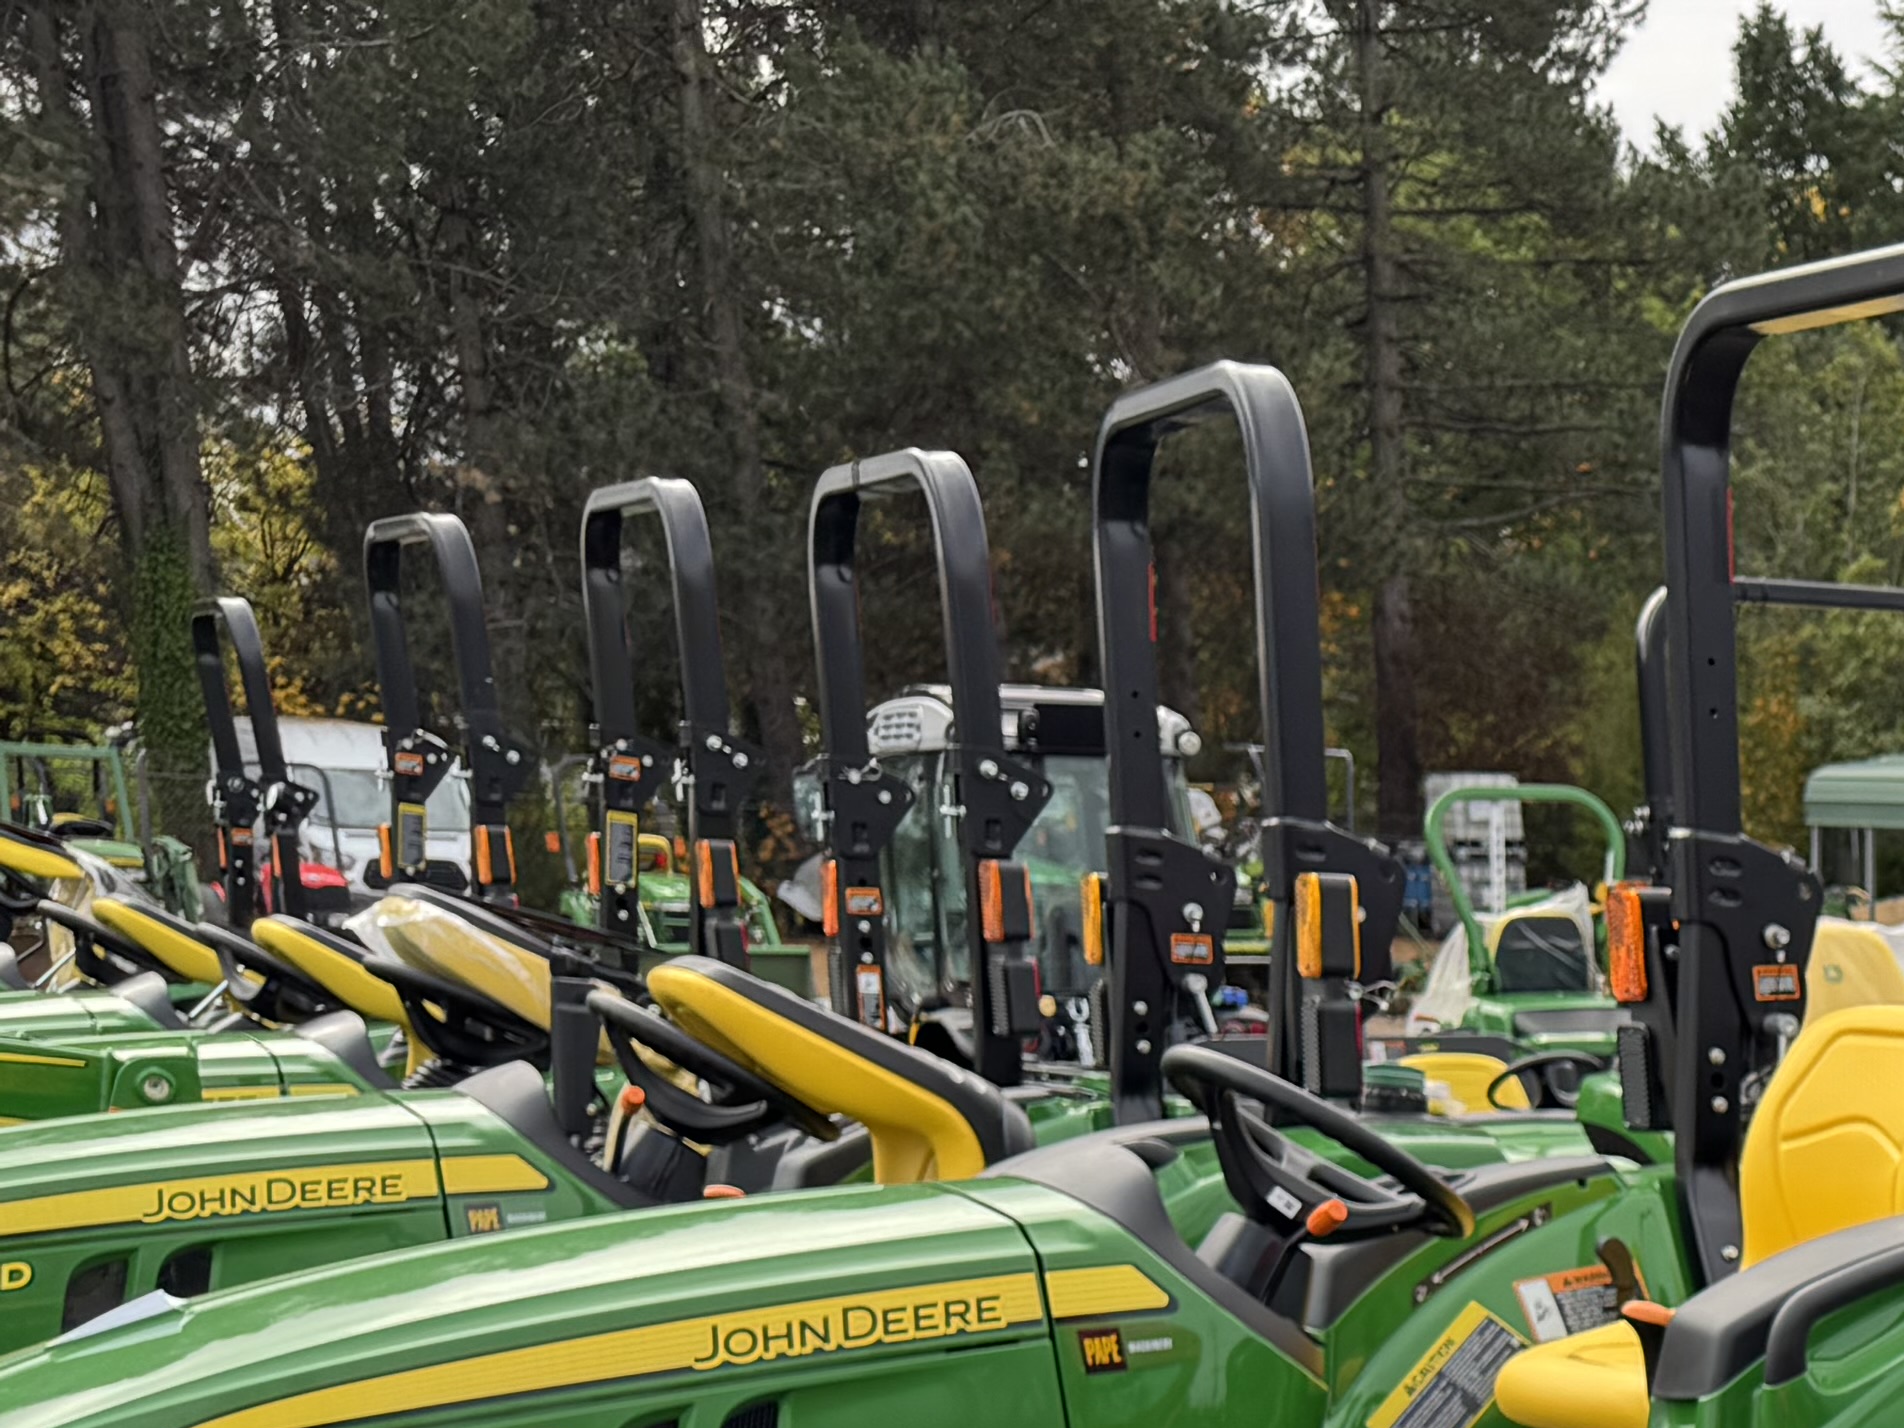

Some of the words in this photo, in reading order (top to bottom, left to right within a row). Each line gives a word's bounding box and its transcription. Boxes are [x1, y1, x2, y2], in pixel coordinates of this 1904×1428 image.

[143, 1183, 257, 1219] JOHN
[265, 1174, 403, 1209] DEERE
[0, 1261, 33, 1291] D
[694, 1314, 831, 1363] JOHN
[841, 1296, 1003, 1344] DEERE
